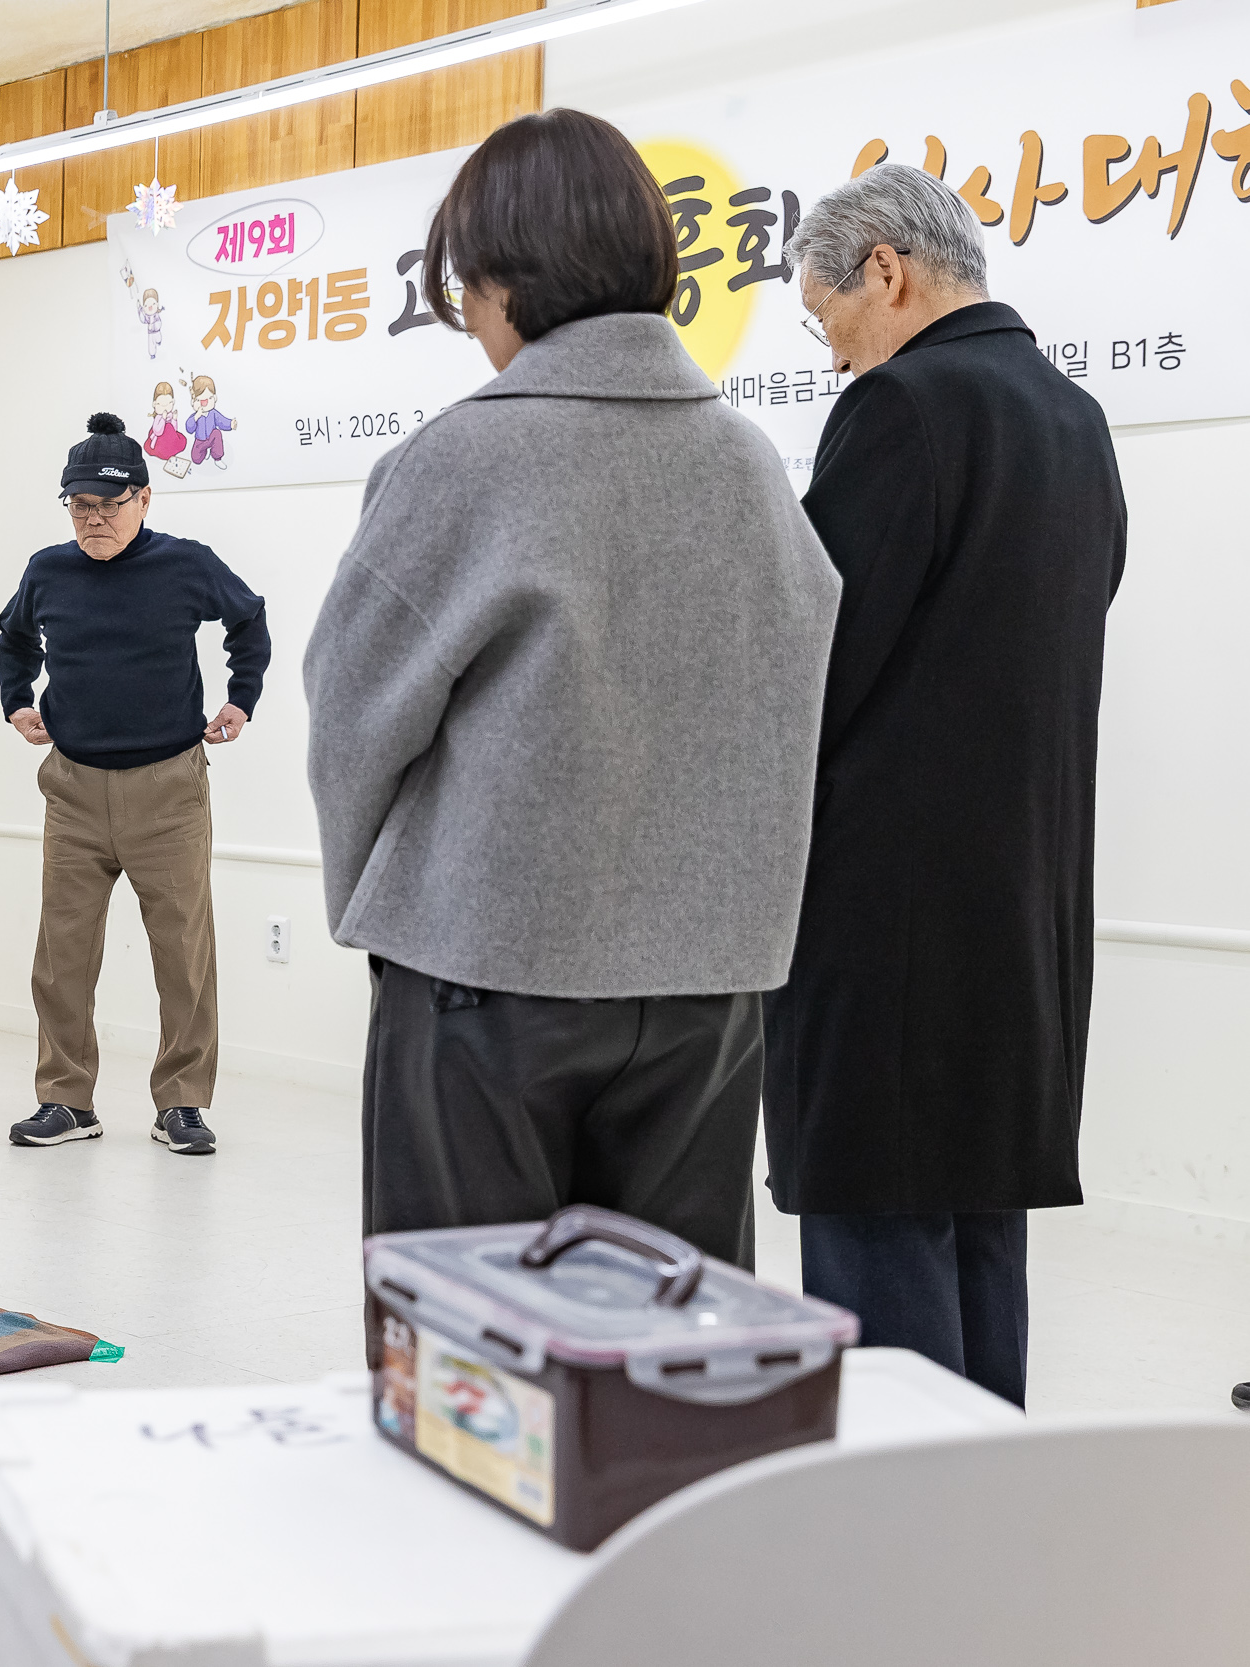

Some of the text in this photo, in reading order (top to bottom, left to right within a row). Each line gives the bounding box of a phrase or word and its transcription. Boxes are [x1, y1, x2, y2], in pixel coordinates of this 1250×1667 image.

[214, 212, 296, 264] 제9회
[201, 267, 371, 352] 자양1동
[1111, 332, 1187, 371] B1층
[295, 416, 331, 446] 일시
[349, 412, 407, 439] 2026.
